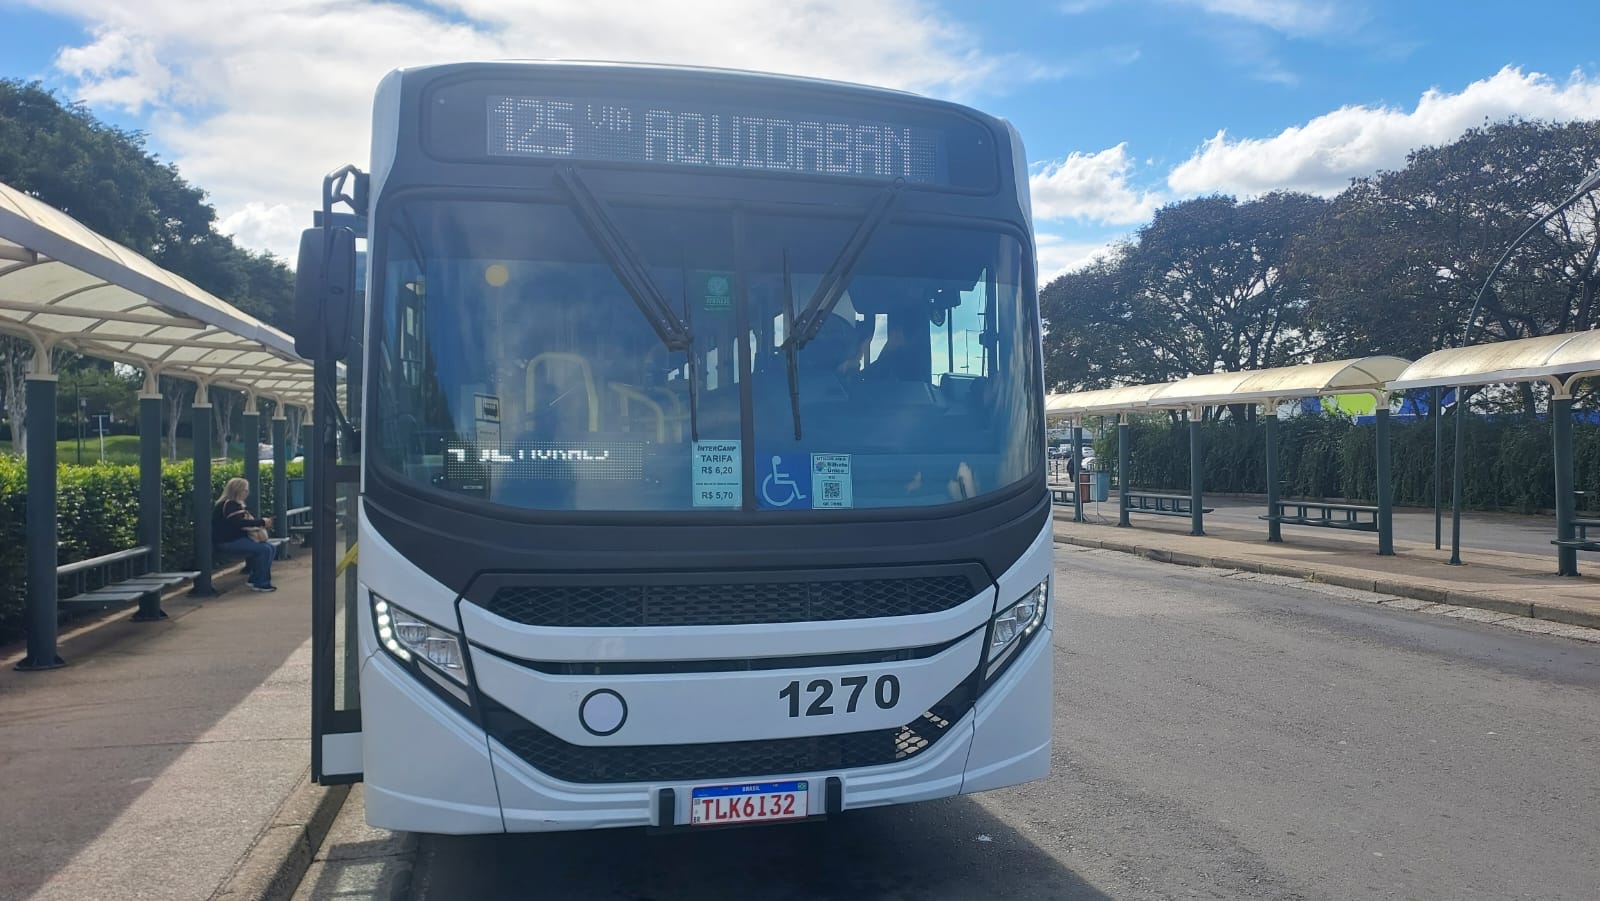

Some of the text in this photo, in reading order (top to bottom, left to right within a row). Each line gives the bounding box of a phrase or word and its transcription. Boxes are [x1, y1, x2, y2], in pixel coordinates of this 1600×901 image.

[494, 97, 910, 176] 125 VIA AQUIDABAN
[701, 454, 733, 463] TARIFA
[701, 466, 733, 476] R$ 6,20
[701, 491, 733, 500] R$ 5,70
[779, 674, 900, 718] 1270
